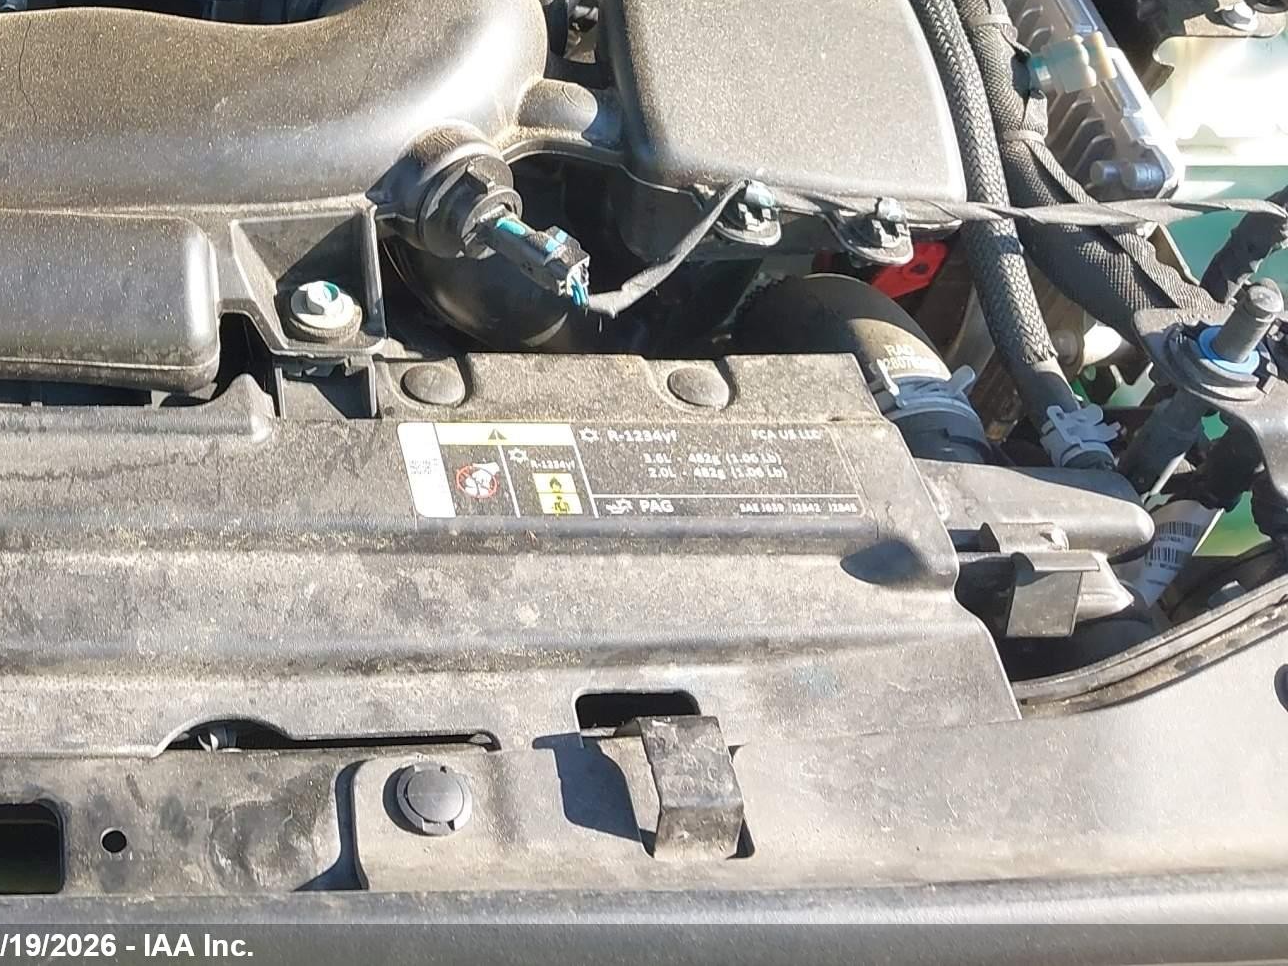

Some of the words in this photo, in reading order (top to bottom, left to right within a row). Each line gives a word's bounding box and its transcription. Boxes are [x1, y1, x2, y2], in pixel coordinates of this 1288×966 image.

[884, 344, 916, 356] RAD
[607, 429, 678, 444] R-1234yf
[751, 429, 777, 441] FCA
[647, 467, 676, 478] 2.0L
[639, 499, 674, 513] PAG
